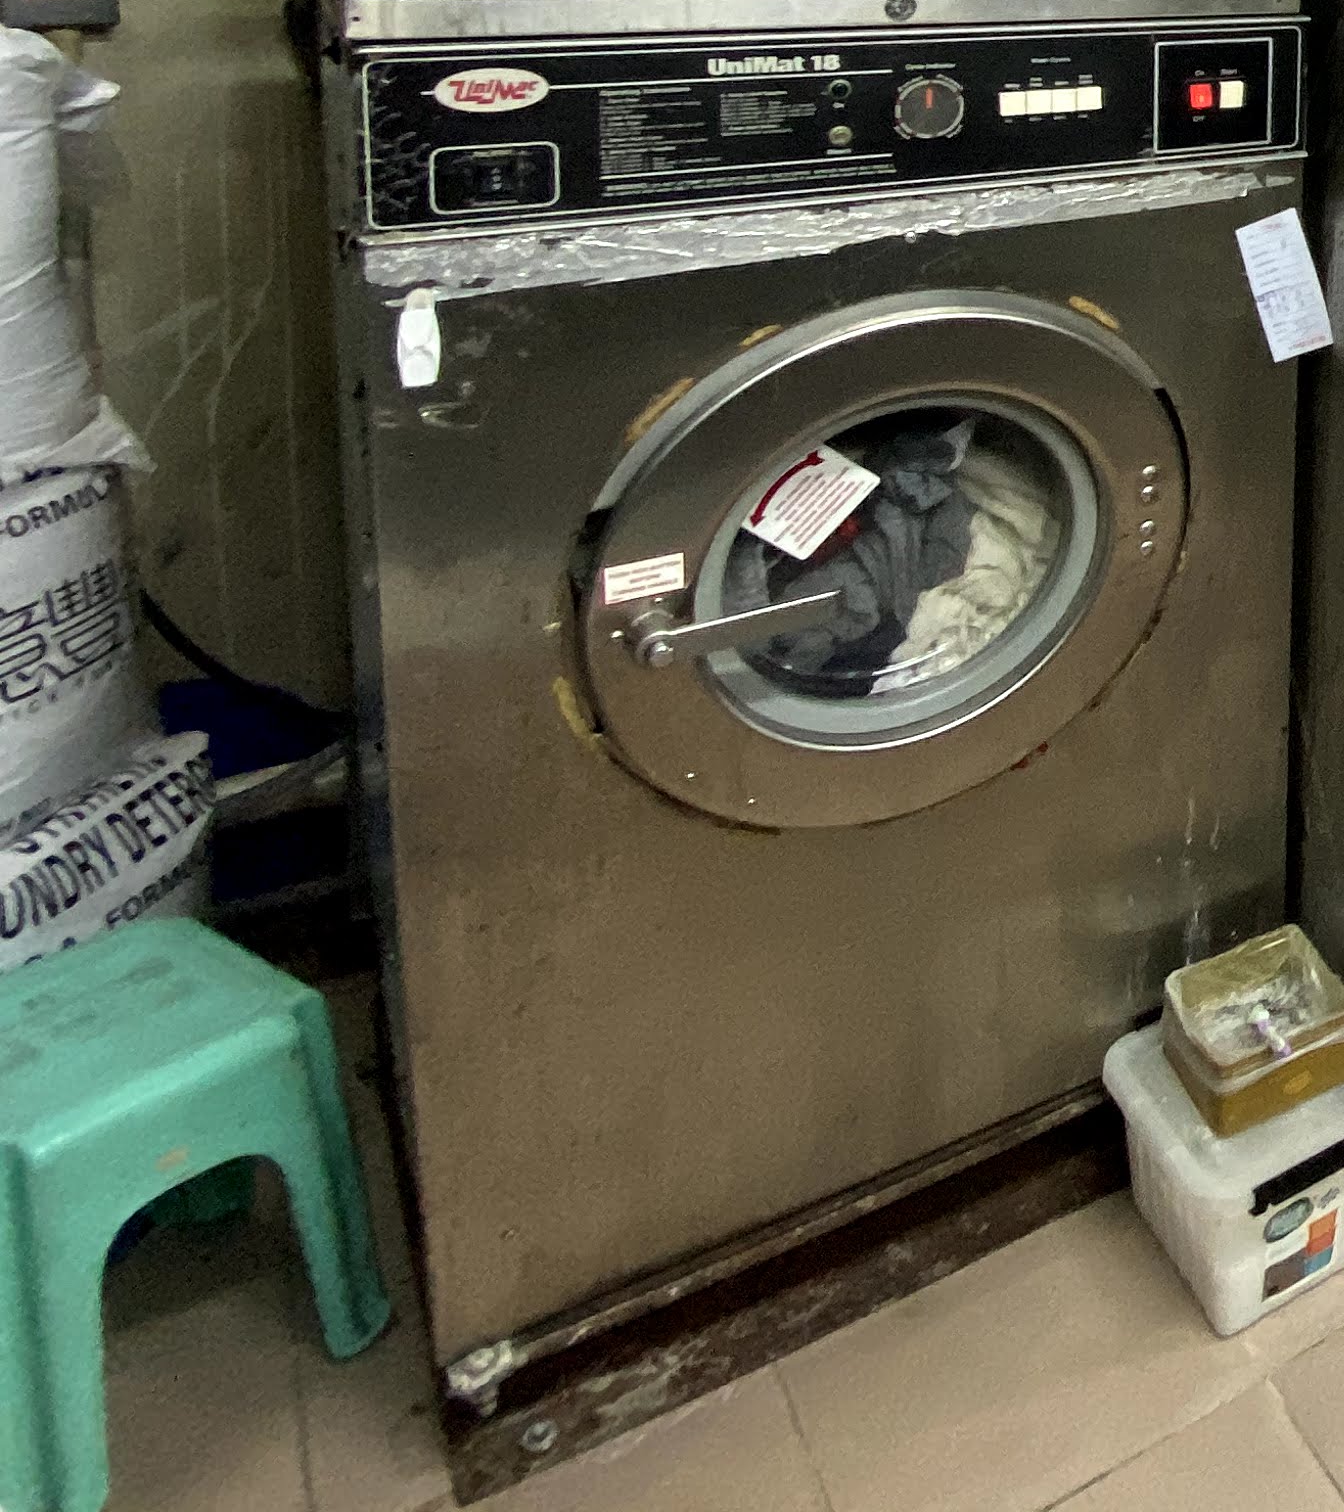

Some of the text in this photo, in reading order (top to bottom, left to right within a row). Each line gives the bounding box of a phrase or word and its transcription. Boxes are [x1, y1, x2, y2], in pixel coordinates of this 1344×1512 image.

[707, 54, 841, 76] UniMat 18
[0, 463, 123, 538] ORMULA
